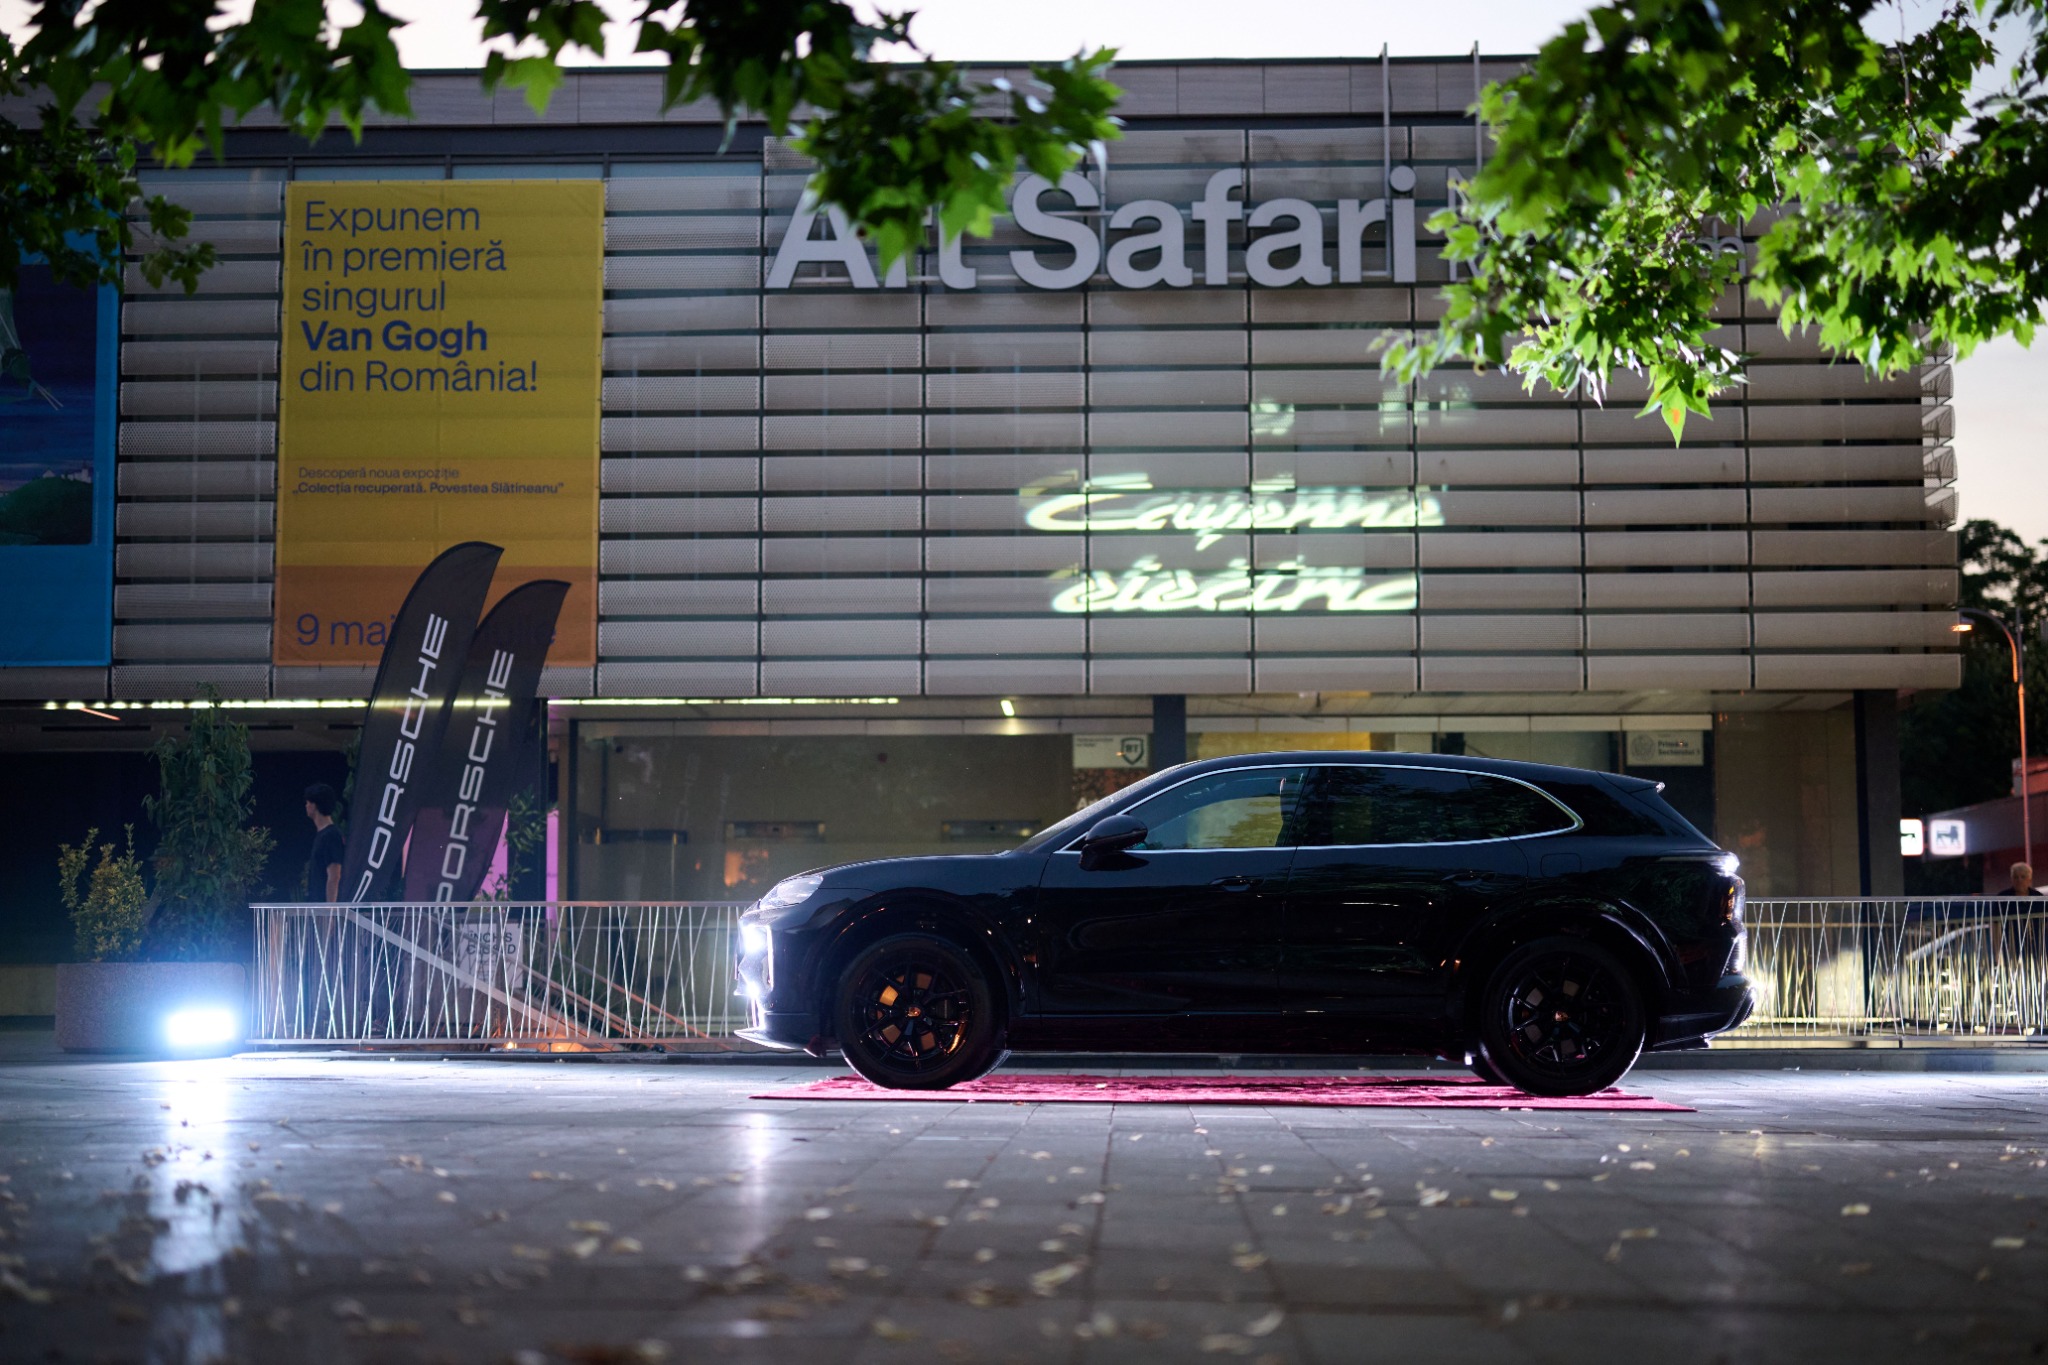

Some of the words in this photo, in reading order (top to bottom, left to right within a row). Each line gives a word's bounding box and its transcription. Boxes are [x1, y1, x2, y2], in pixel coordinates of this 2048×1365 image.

[305, 200, 480, 237] Expunem
[764, 171, 977, 290] At
[1009, 166, 1417, 290] Safari
[301, 240, 333, 272] în
[343, 239, 507, 277] premieră
[302, 280, 446, 318] singurul
[301, 320, 372, 351] Van
[382, 320, 488, 358] Gogh
[300, 361, 354, 392] din
[366, 360, 537, 392] România!
[299, 467, 366, 481] Descoperă
[369, 470, 400, 479] noua
[430, 482, 488, 493] Povestea
[297, 613, 320, 646] 9
[352, 612, 449, 903] PORSCHE
[434, 649, 515, 914] PORSCHE
